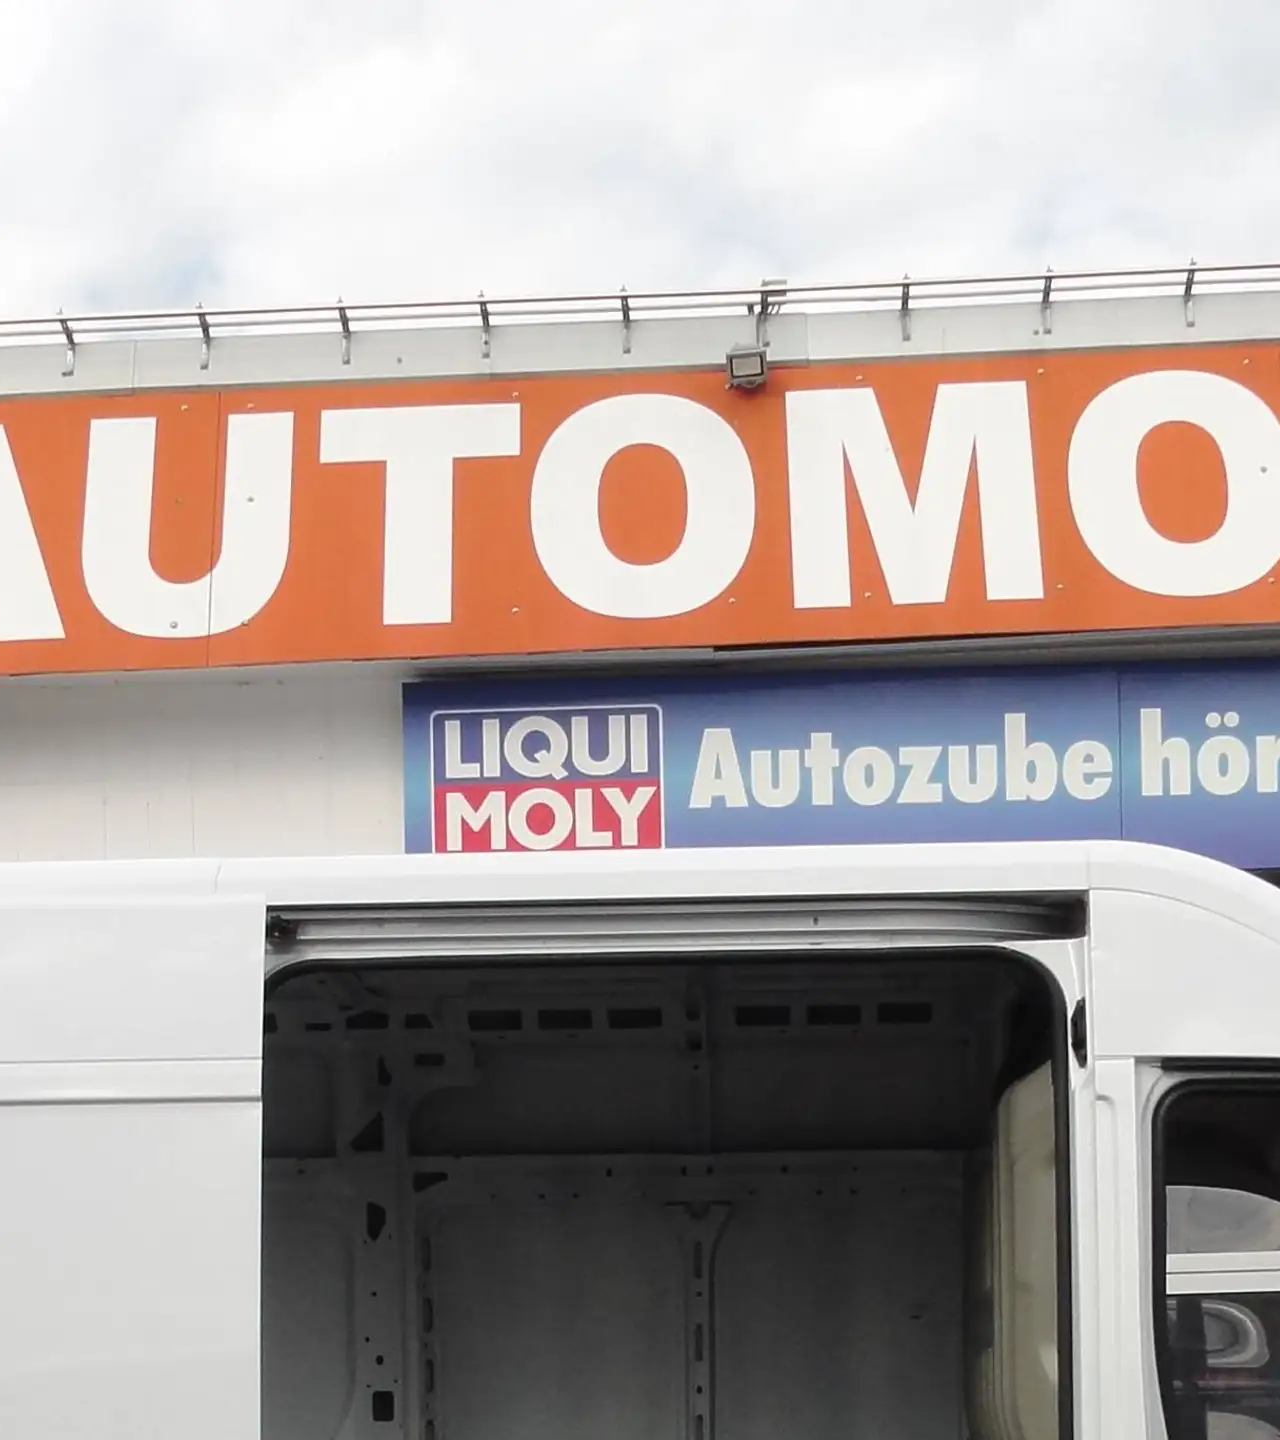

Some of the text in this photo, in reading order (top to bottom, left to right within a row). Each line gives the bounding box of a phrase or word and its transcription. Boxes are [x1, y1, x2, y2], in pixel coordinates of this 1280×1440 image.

[443, 713, 650, 781] LIQUI
[687, 712, 1115, 810] Autozube
[444, 786, 657, 852] MOLY
